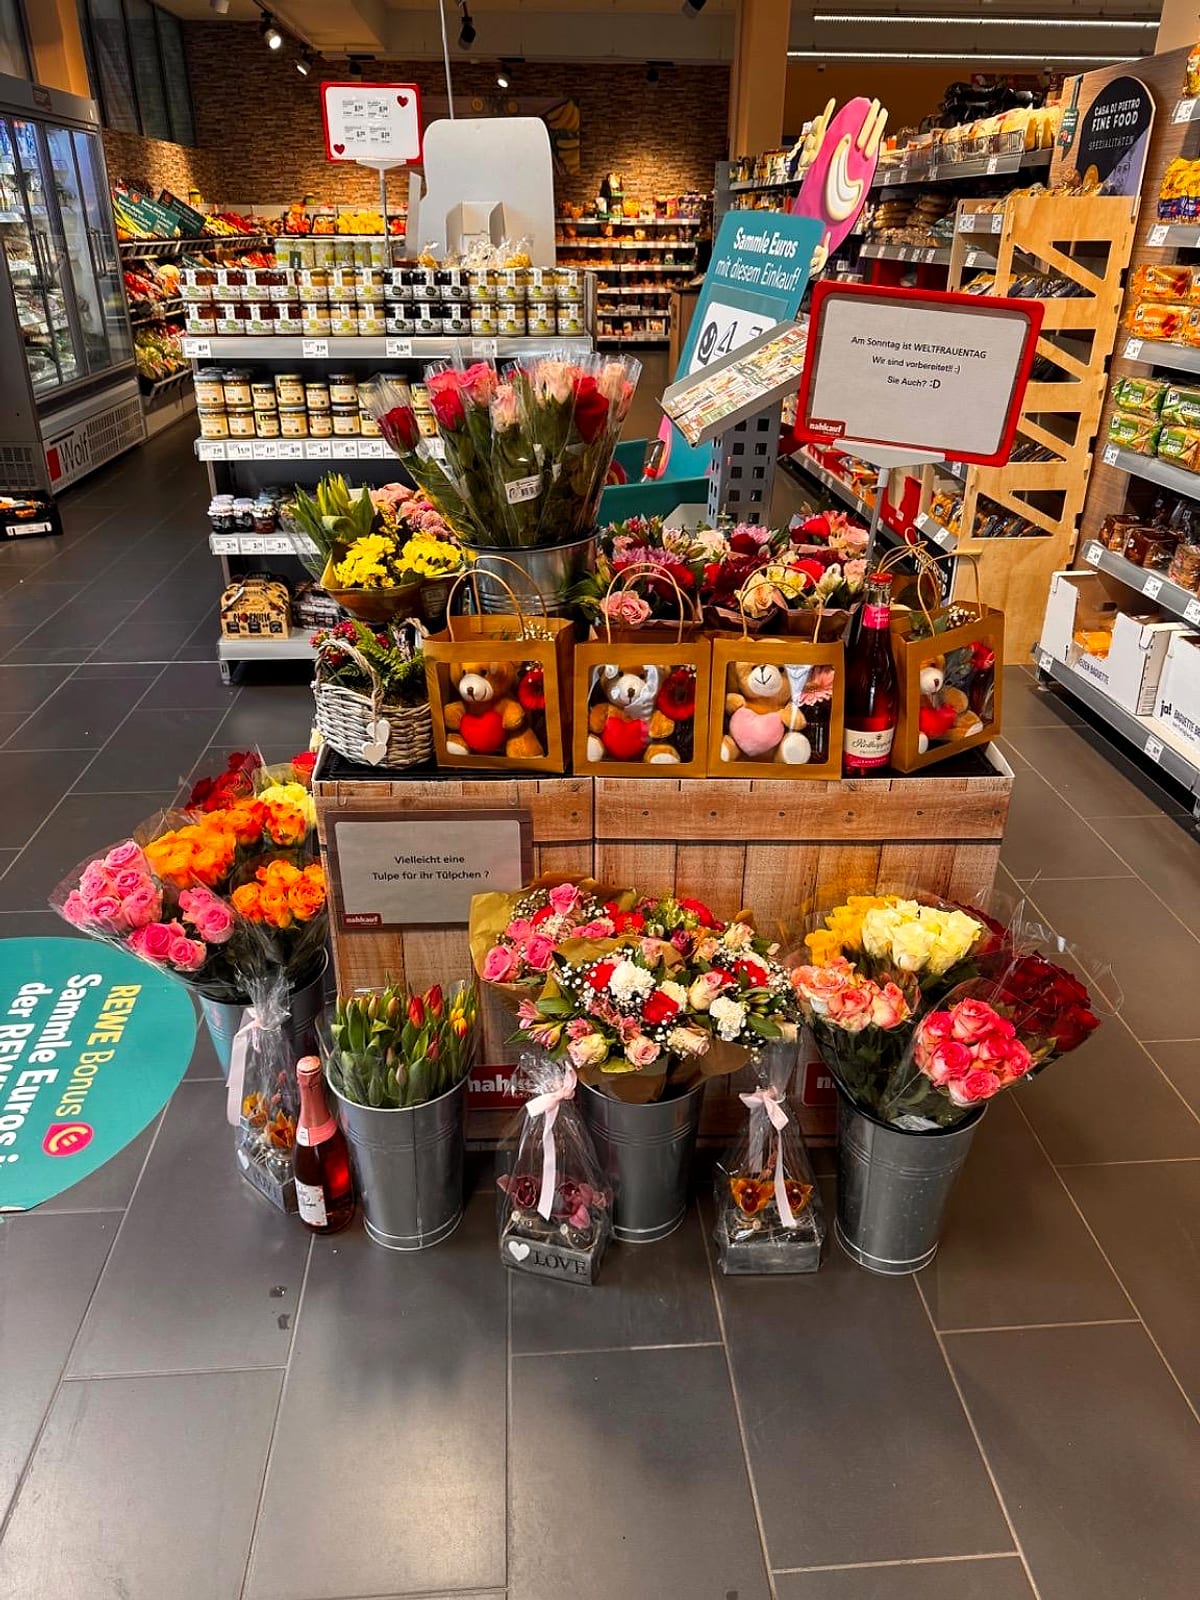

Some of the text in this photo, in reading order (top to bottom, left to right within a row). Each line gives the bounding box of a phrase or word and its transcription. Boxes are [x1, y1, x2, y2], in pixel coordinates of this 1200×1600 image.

[1091, 115, 1112, 132] FINE
[1113, 111, 1139, 128] FOOD
[733, 226, 799, 258] Sammle Euros
[715, 255, 802, 292] mit diesem Einkauf!
[851, 336, 987, 359] Am Sonntag ist WELTFRAUENTAG
[872, 355, 885, 366] Wir
[887, 357, 904, 367] sind
[887, 376, 899, 385] Sie
[901, 377, 927, 388] Auch?
[809, 421, 842, 433] nahkauf
[60, 431, 91, 475] Wolf
[1160, 699, 1172, 718] ja!
[394, 856, 465, 865] Vielleicht eine
[372, 871, 400, 881] Tulpe
[402, 870, 418, 880] für
[436, 870, 482, 881] Tülpchen
[484, 870, 490, 879] ?
[345, 915, 378, 924] nahkauf
[7, 982, 54, 1019] der
[0, 973, 103, 1147] Sammle Euros
[55, 983, 142, 1118] REWE Bonus
[533, 1250, 587, 1276] LOVE
